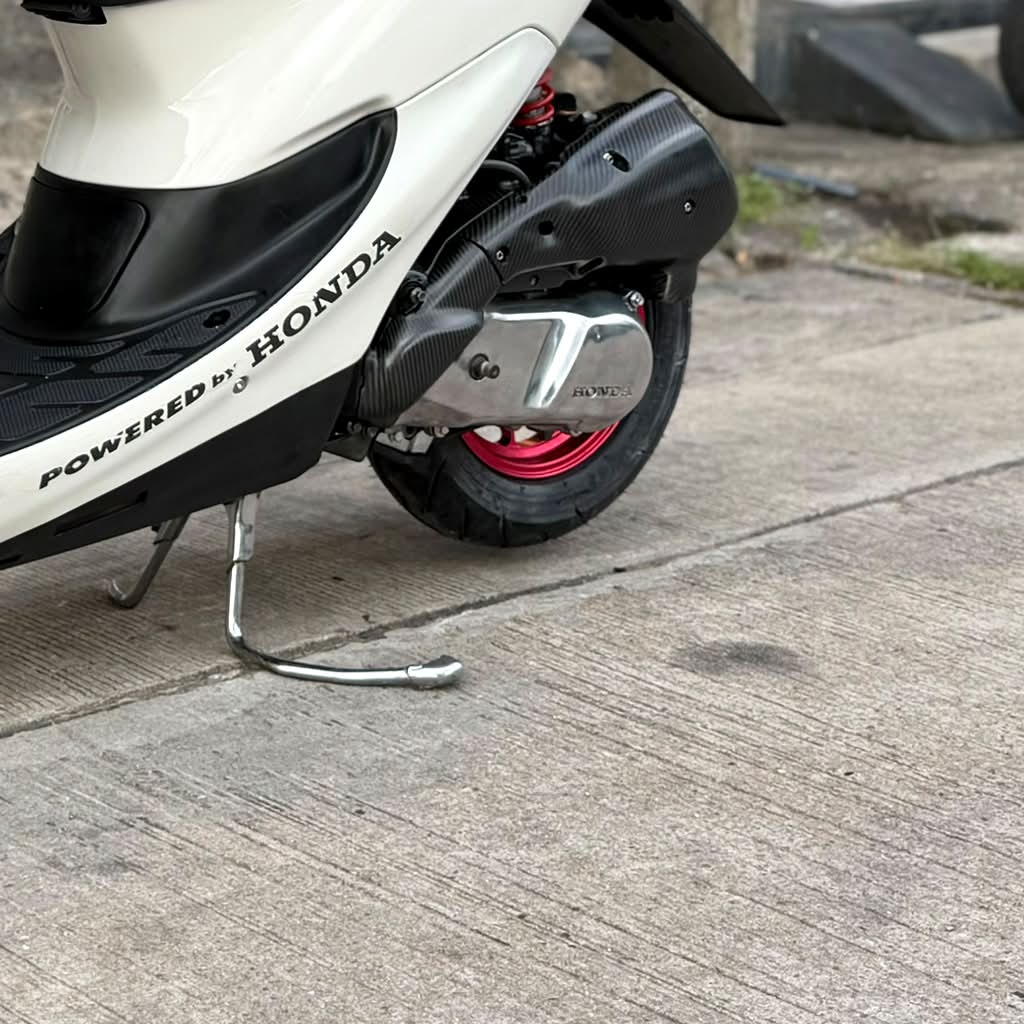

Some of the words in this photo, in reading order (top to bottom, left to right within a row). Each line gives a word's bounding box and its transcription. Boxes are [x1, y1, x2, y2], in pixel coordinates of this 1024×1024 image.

[39, 382, 206, 489] POWERED
[246, 231, 401, 367] HONDA
[573, 385, 633, 398] HONDA
